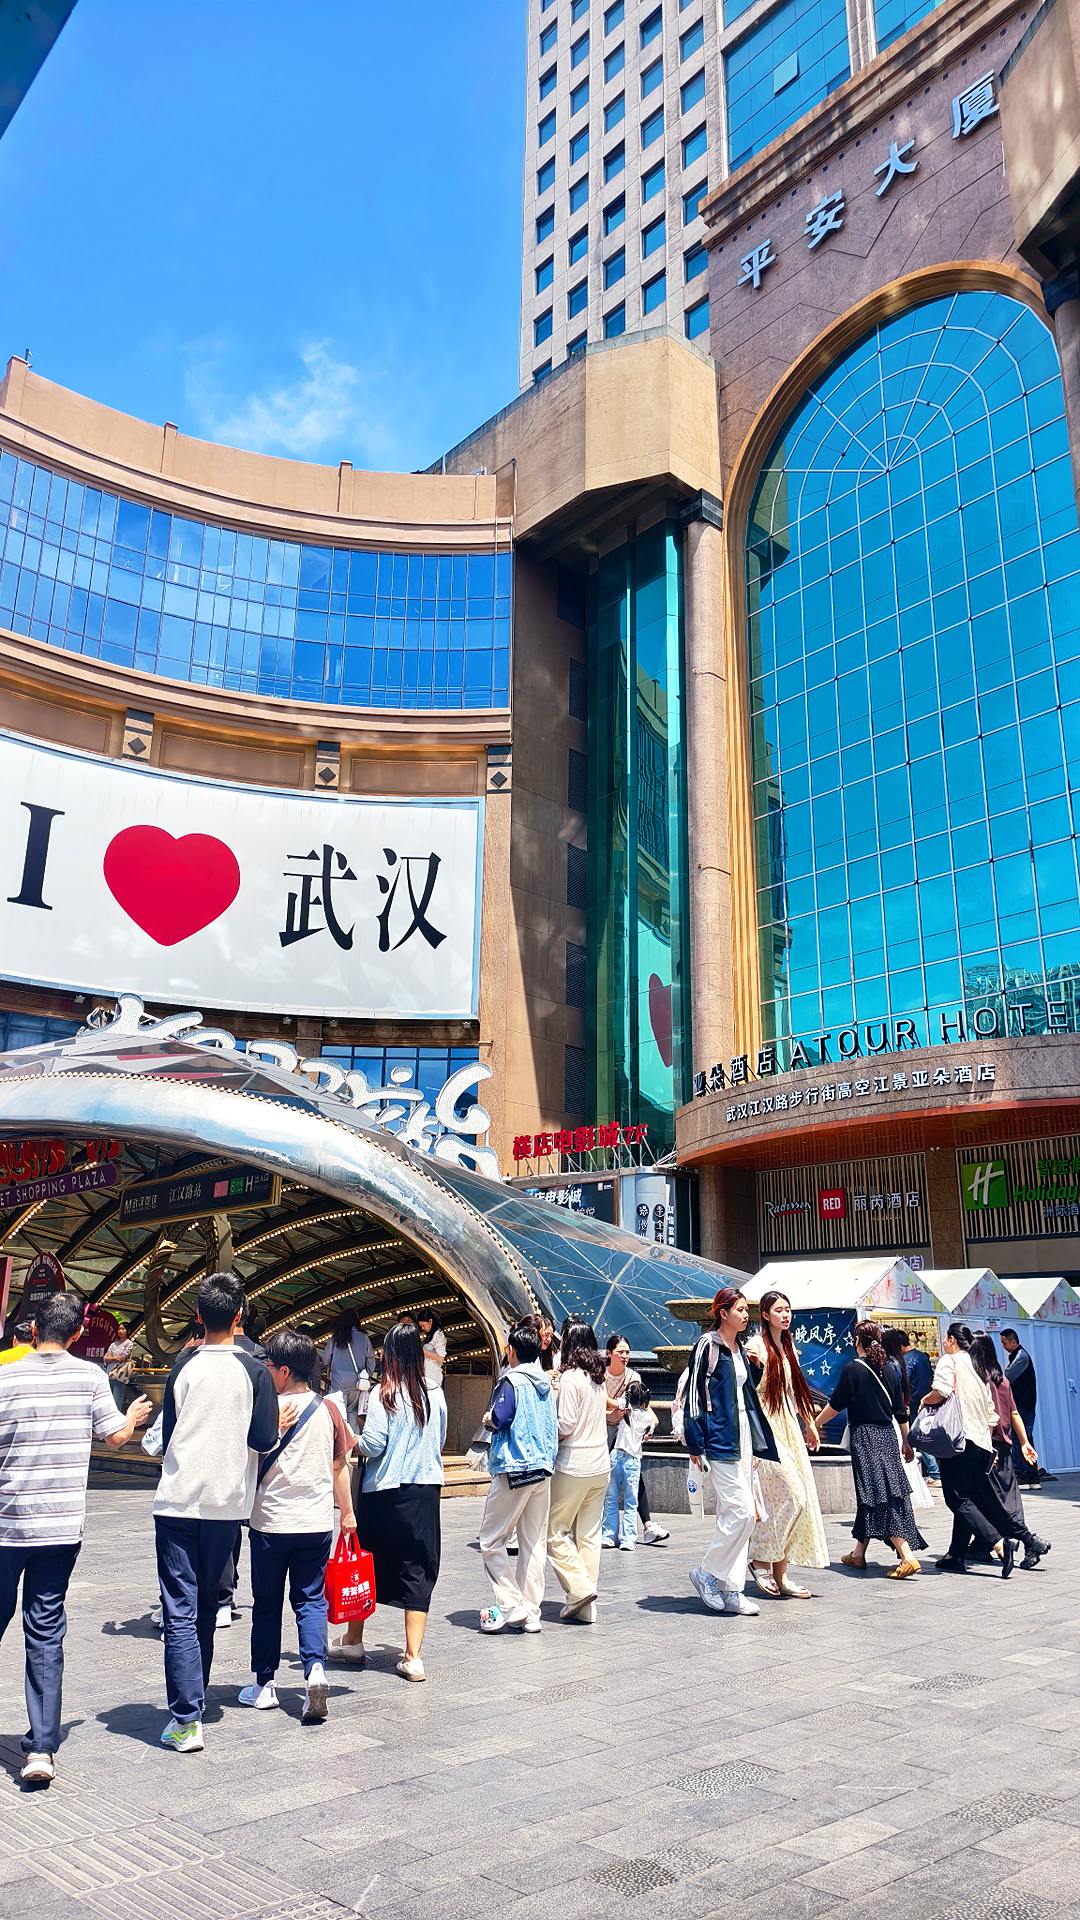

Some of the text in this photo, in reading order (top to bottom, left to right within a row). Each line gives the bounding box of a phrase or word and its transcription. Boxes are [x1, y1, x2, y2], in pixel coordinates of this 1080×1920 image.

[737, 68, 1000, 289] 平安大厦
[7, 801, 448, 952] I 武汉
[694, 1000, 1068, 1097] 亚朵酒店 ATOUR HOTE
[725, 1063, 996, 1122] 武汉江汉路步行街高空江景亚朵酒店
[16, 1178, 66, 1202] SHOPPING
[71, 1170, 106, 1190] PLAZA
[245, 1175, 253, 1192] H
[1013, 1184, 1078, 1203] Holiday
[765, 1191, 921, 1218] Radisson RED 丽芮酒店
[795, 1323, 836, 1345] 晚风序
